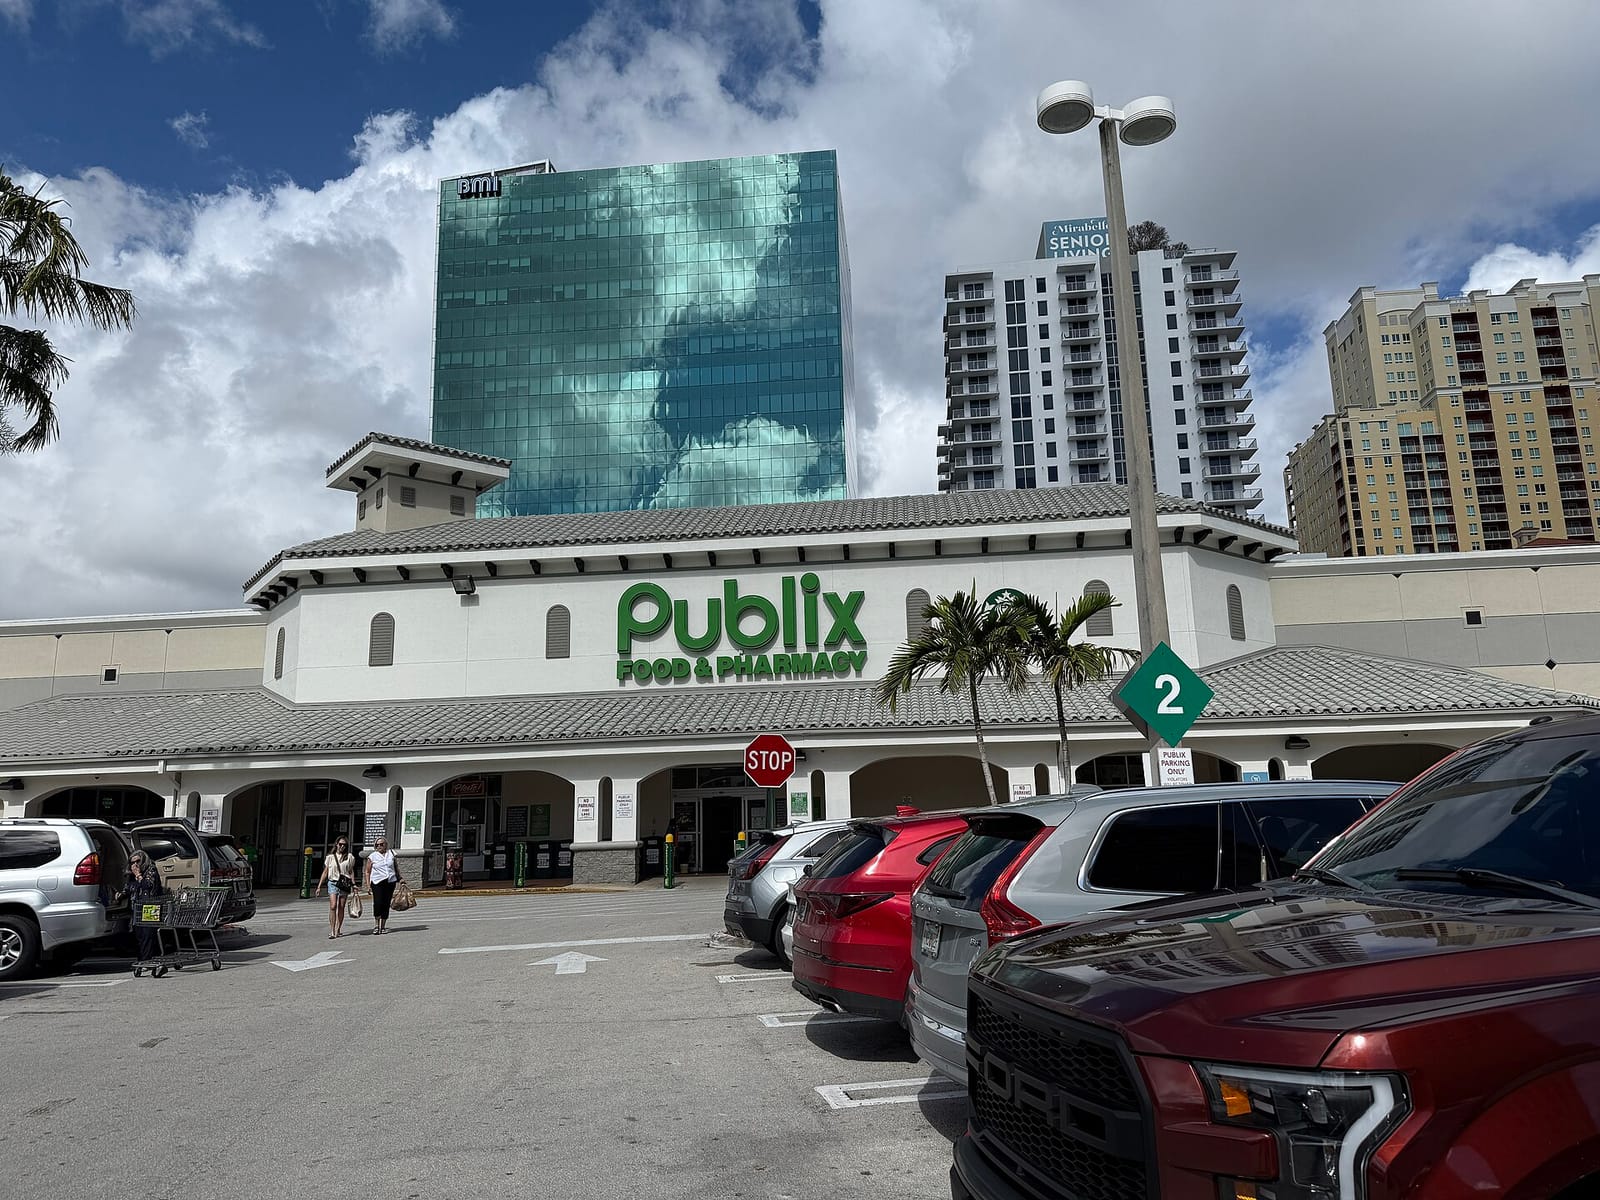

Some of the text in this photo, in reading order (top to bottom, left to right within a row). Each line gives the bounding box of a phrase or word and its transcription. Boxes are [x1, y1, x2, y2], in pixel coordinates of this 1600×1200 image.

[1049, 233, 1109, 250] SENIO
[617, 572, 867, 654] Publix
[617, 651, 868, 680] FOOD & PHARMACY
[1154, 673, 1184, 715] 2
[747, 750, 792, 770] STOP
[1162, 751, 1186, 759] PUBLIX
